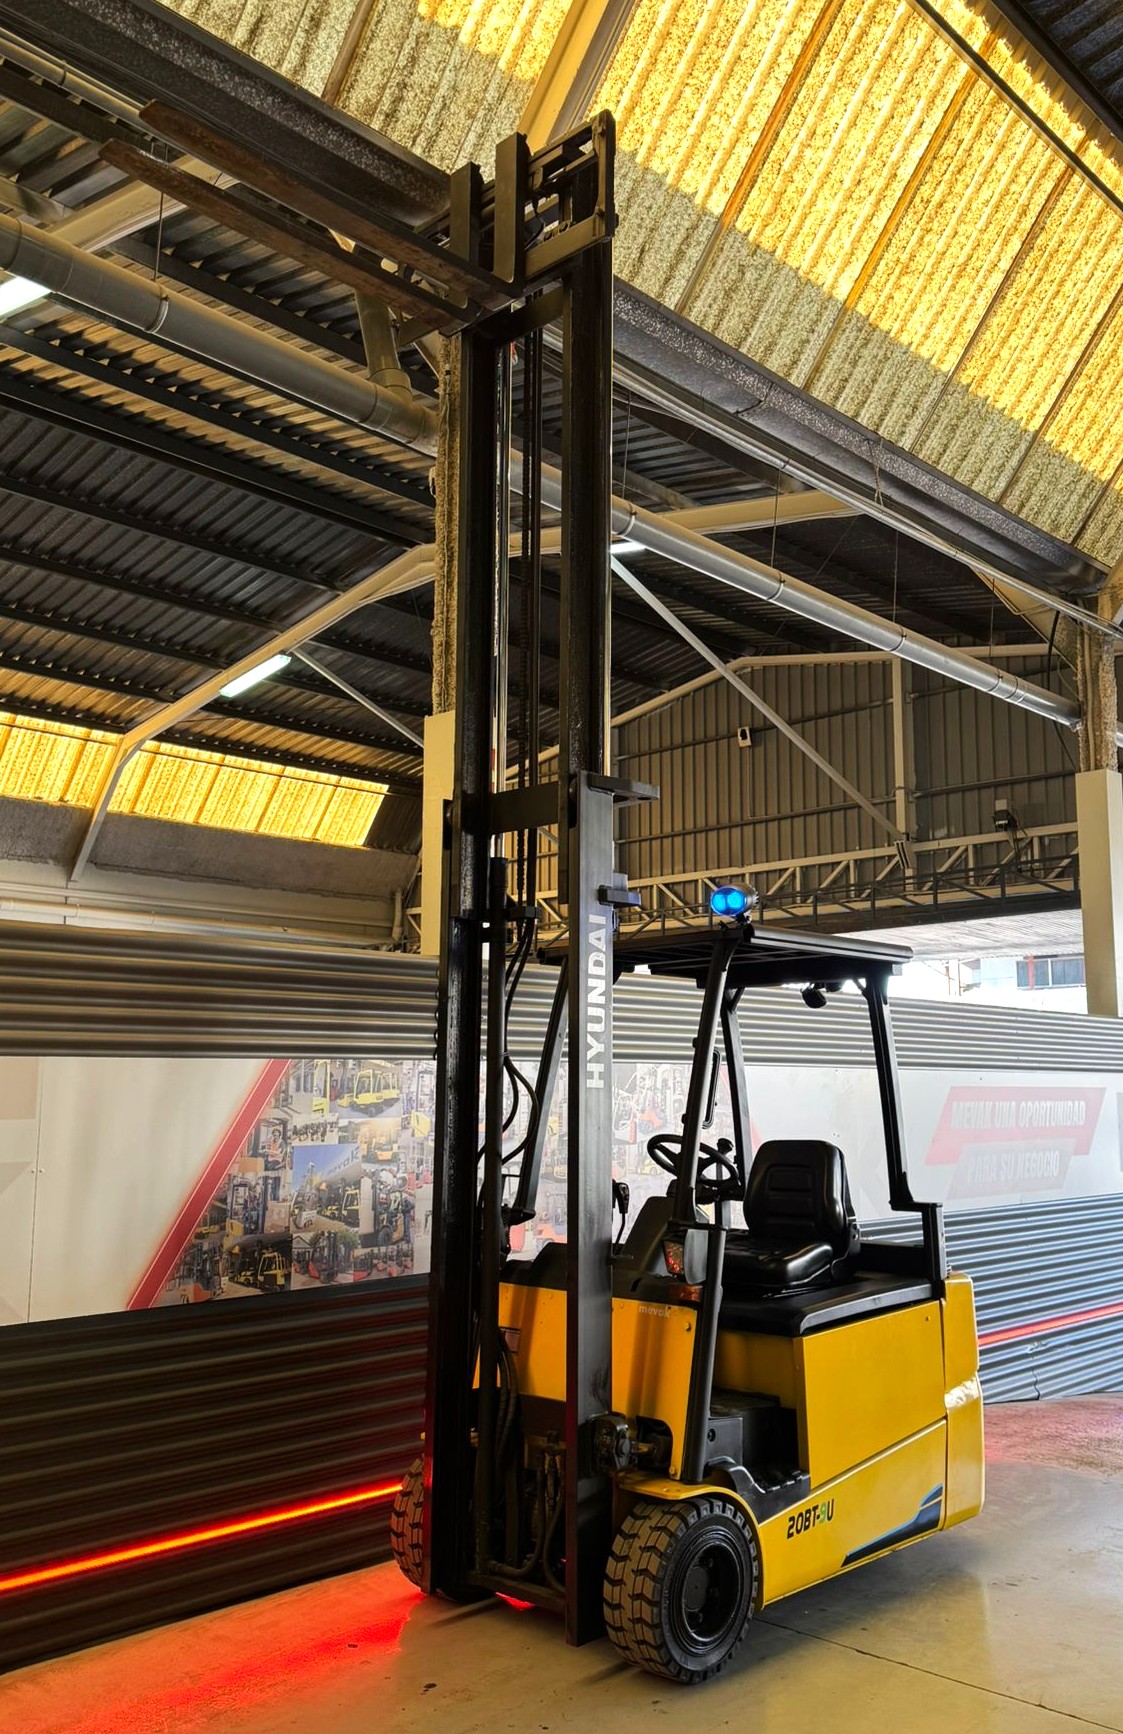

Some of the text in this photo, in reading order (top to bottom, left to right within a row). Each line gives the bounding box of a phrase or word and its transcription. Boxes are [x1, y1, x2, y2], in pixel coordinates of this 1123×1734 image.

[587, 914, 606, 1088] HYUNDAI
[995, 1101, 1016, 1128] UNA
[1018, 1100, 1086, 1128] OPORTUNIDAD
[967, 1149, 1060, 1184] PARA SU NEGOCIO
[787, 1499, 834, 1539] 20BT-9U
